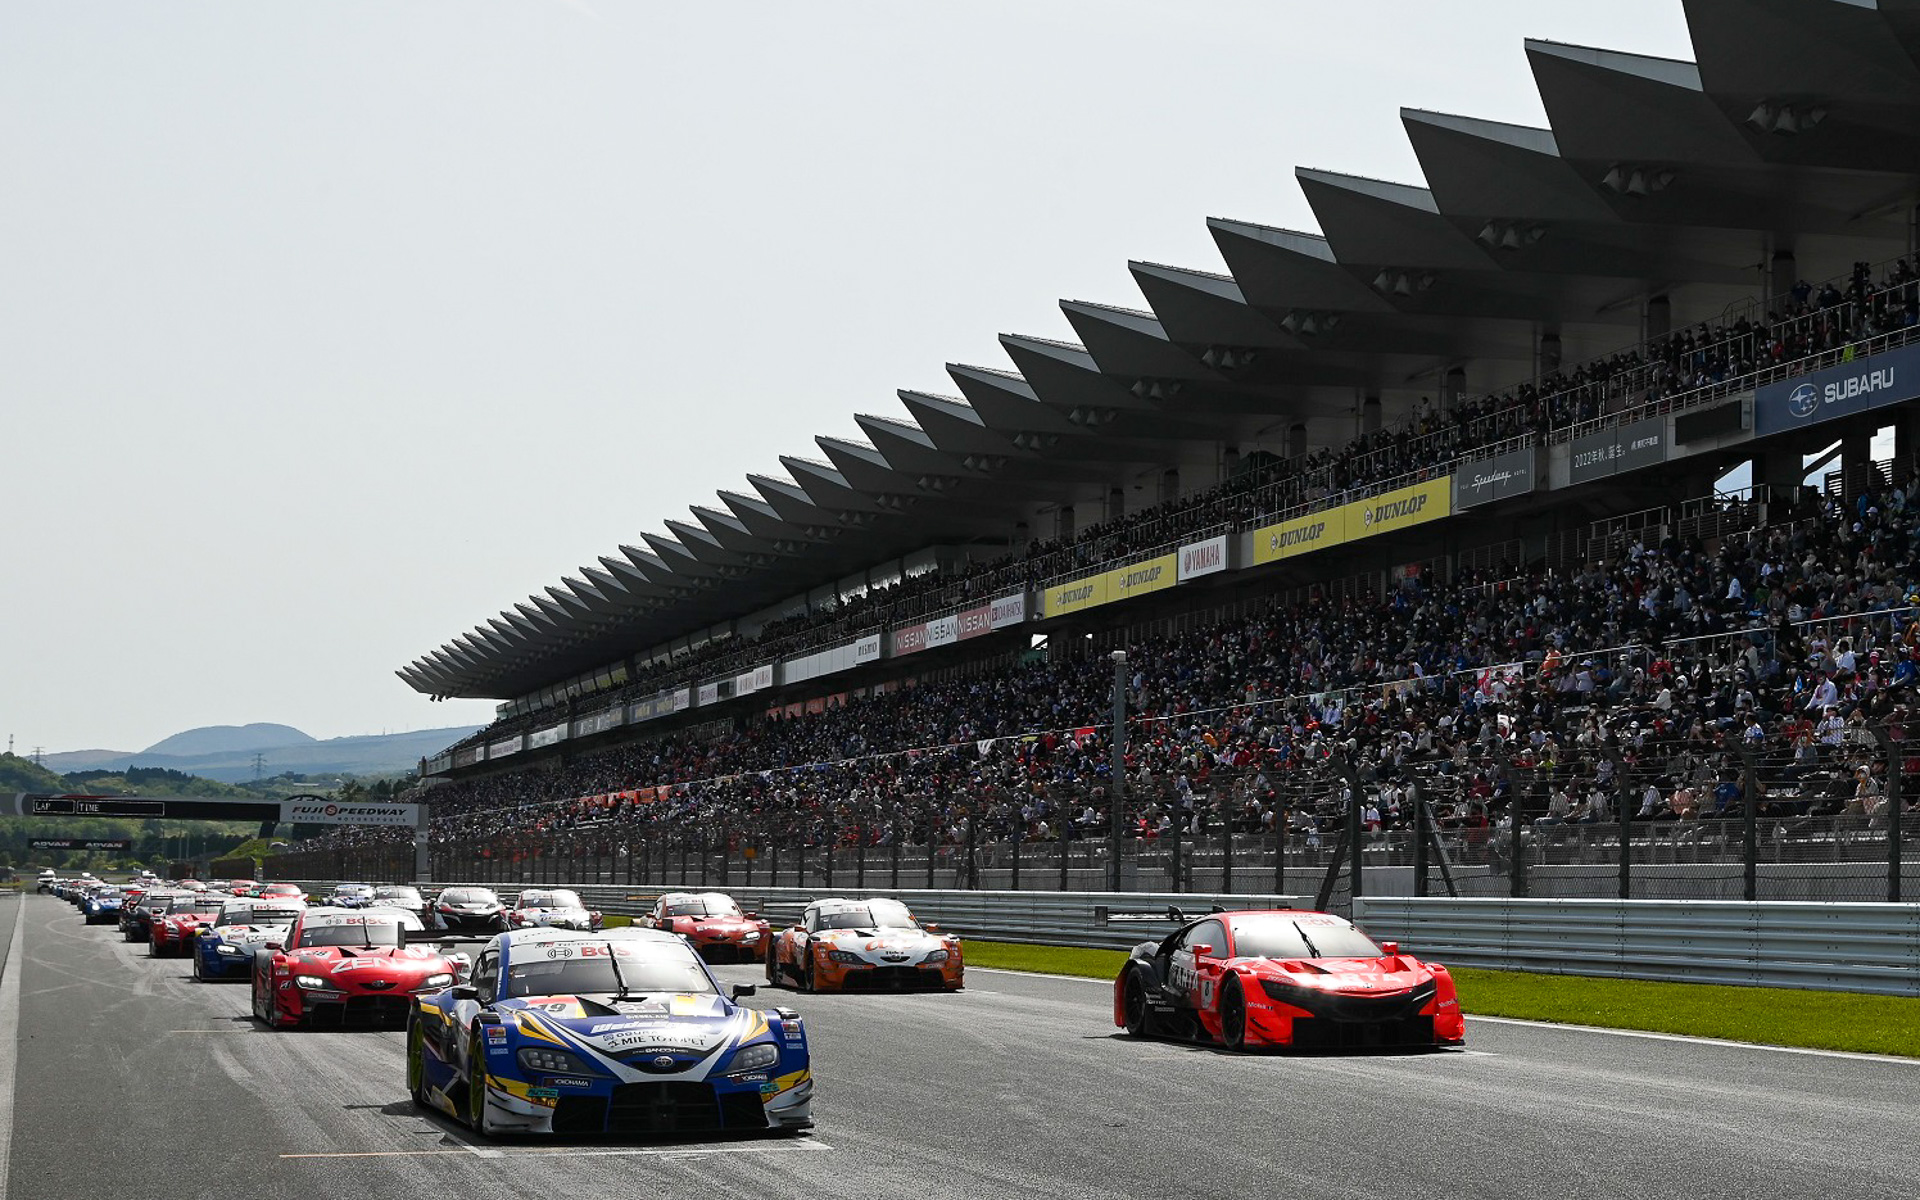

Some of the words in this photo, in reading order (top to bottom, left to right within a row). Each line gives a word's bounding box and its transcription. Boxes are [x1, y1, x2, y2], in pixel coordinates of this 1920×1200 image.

[1825, 367, 1894, 403] SUBARU
[1374, 494, 1427, 524] DUNLOP
[1279, 522, 1325, 548] DUNLOP
[1192, 544, 1220, 571] YAMAHA
[1126, 566, 1162, 587] DUNLOP
[1062, 585, 1094, 604] DUNLOP
[926, 620, 957, 641] NISSAN
[958, 612, 991, 634] NISSAN
[897, 630, 925, 650] NISSAN
[80, 803, 100, 812] TIME
[325, 804, 407, 816] SPEEDWAY
[581, 946, 632, 958] BOS
[329, 957, 396, 974] ZEN
[1176, 967, 1199, 992] ARTA
[1204, 981, 1210, 997] 8
[540, 1003, 567, 1012] 19
[621, 1035, 647, 1047] MIE
[554, 1079, 589, 1087] YOKOHAMA
